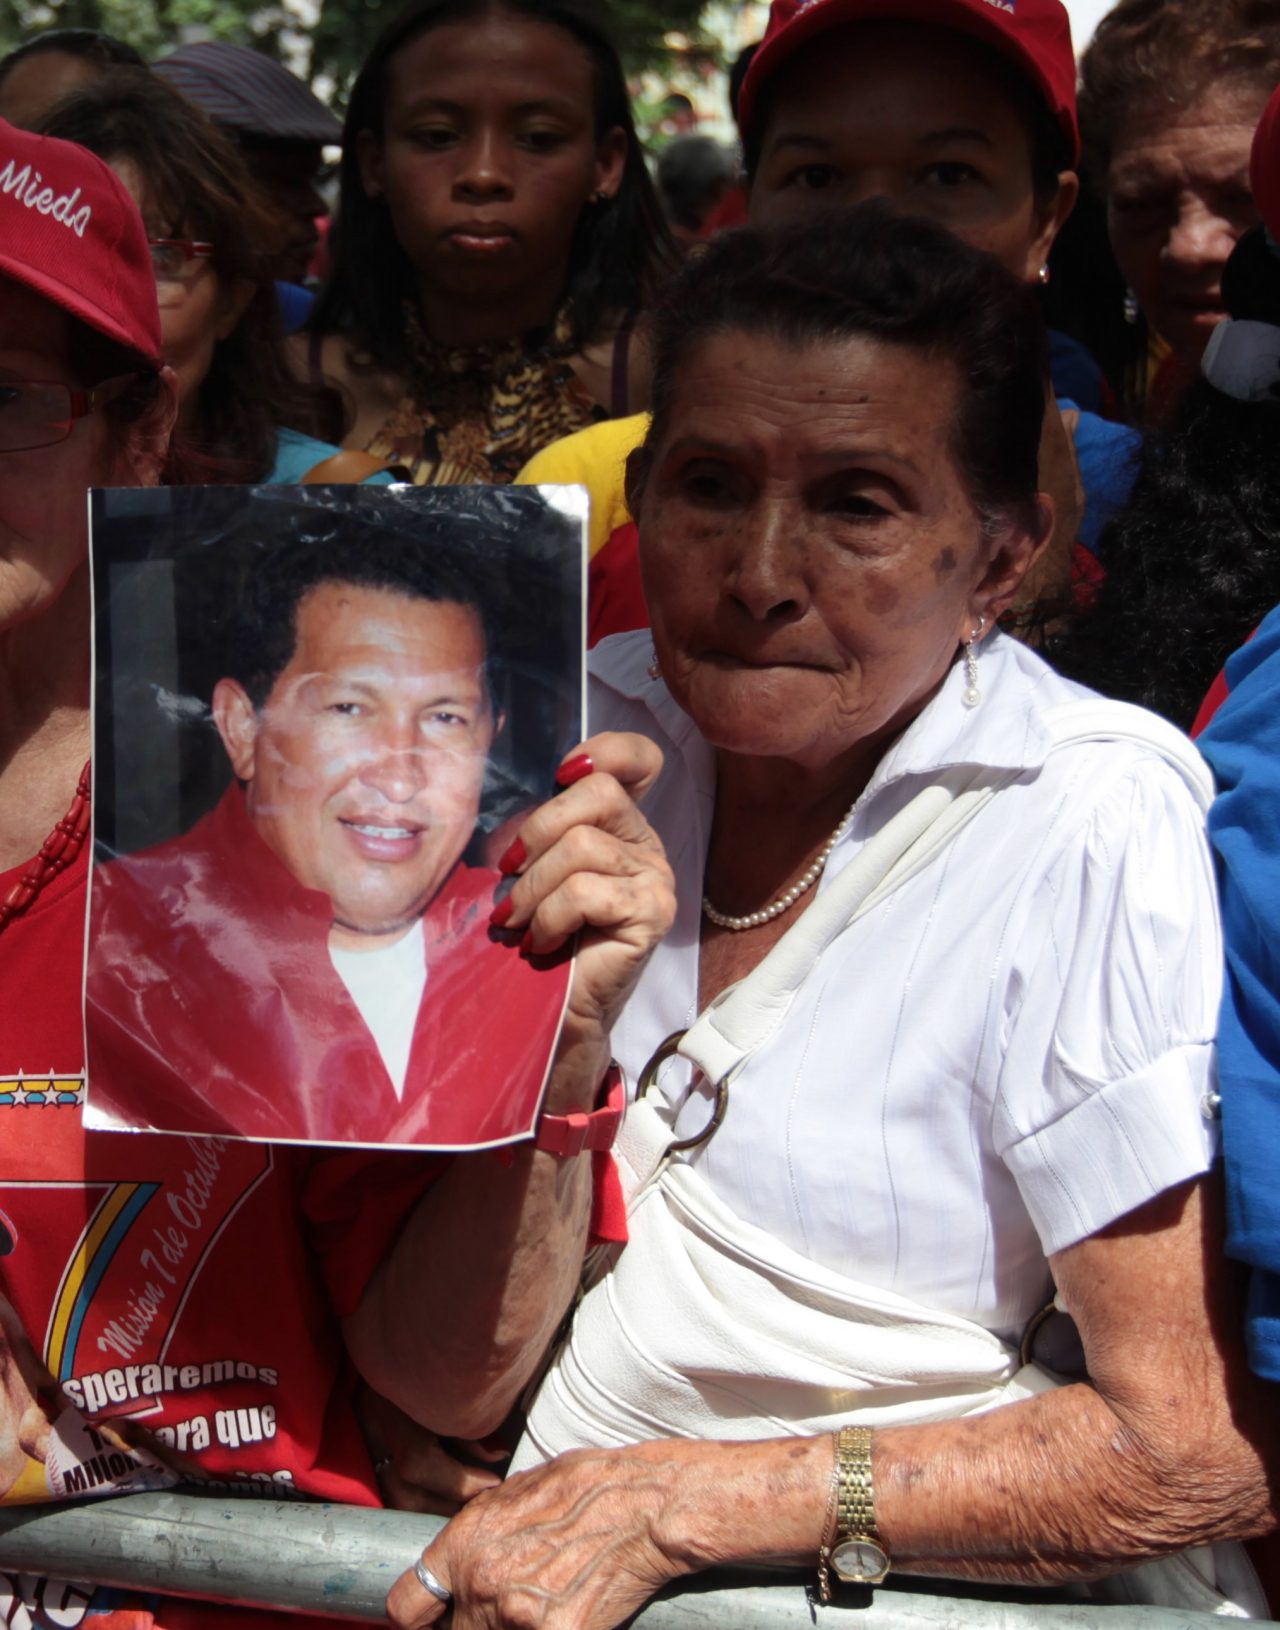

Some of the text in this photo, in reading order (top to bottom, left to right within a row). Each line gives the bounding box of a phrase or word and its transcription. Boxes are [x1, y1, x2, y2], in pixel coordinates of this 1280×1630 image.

[97, 1136, 229, 1359] Misión 7 de Octubr
[62, 1359, 278, 1413] speraremos
[145, 1405, 277, 1452] ara que
[63, 1452, 164, 1492] Millon
